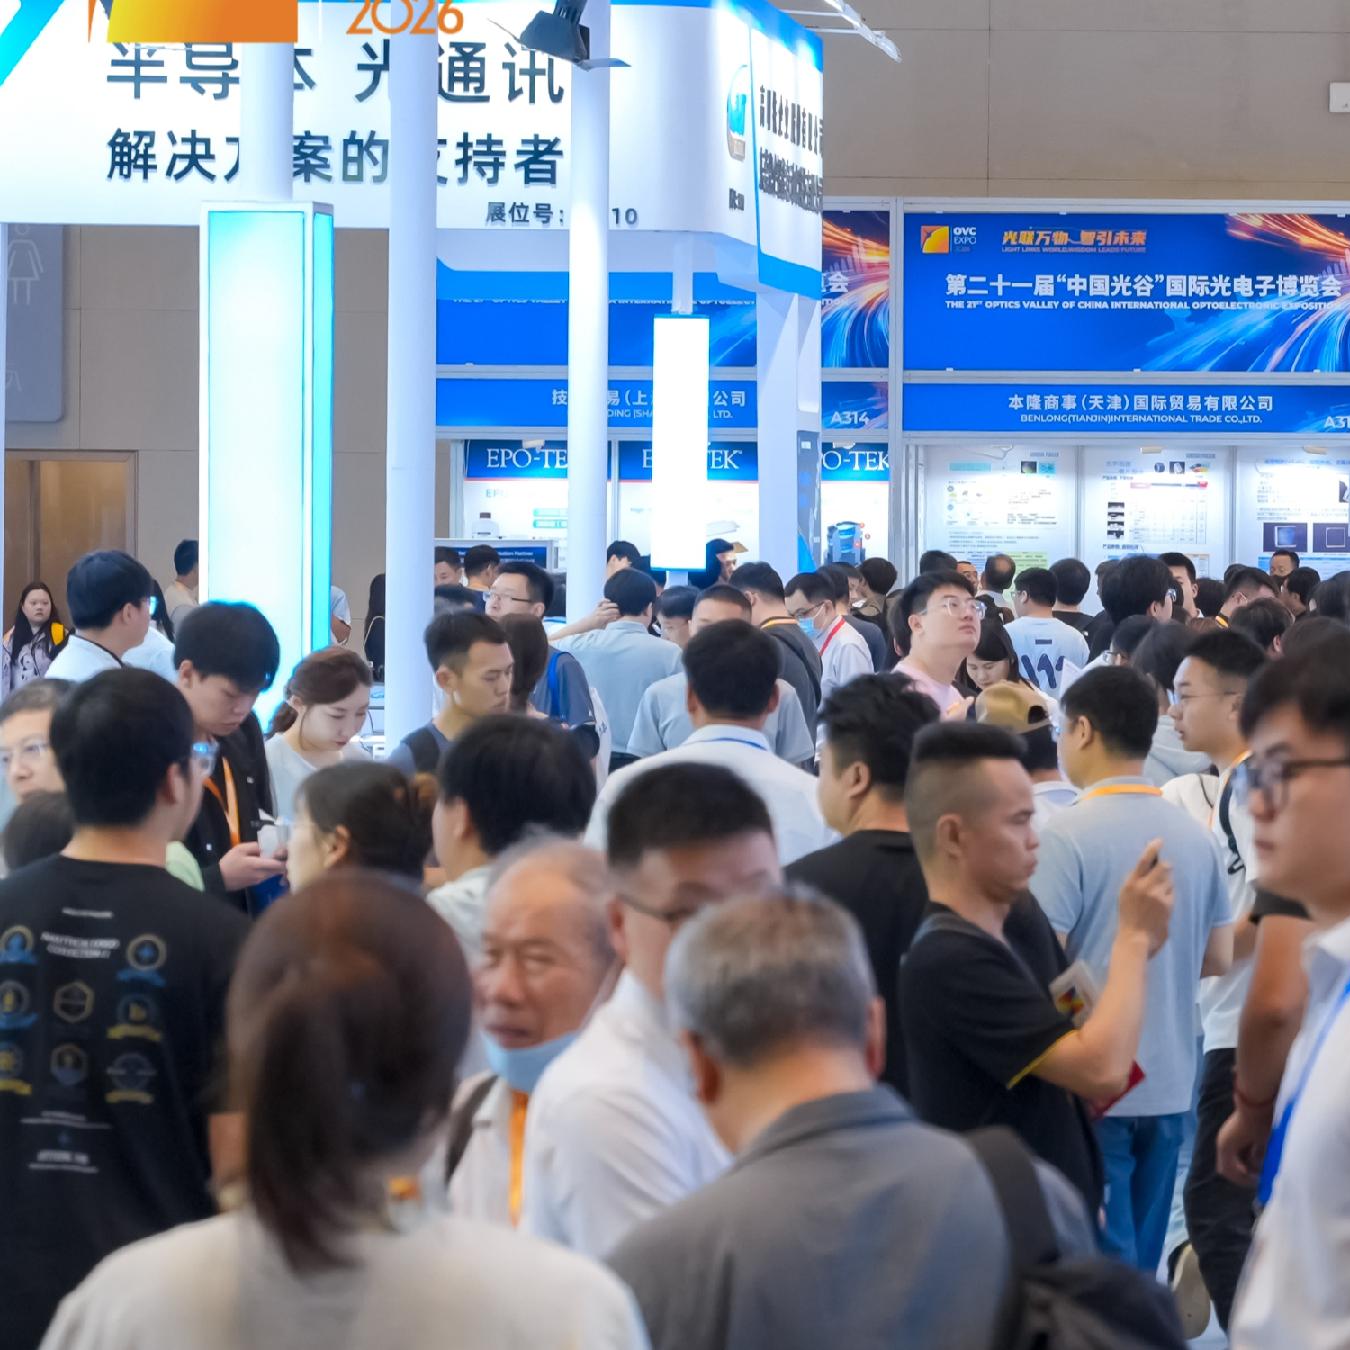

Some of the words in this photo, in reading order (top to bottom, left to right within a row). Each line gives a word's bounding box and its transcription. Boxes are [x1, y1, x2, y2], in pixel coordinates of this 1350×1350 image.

[106, 127, 564, 185] 解决案的持者
[953, 227, 977, 236] OVC
[945, 273, 1342, 297] 第二十一届“中国光谷”国际光电子博览会
[945, 301, 964, 309] THE
[984, 301, 1021, 309] OPTICS
[1022, 301, 1059, 309] VALLEY
[1062, 301, 1076, 309] OF
[1077, 301, 1109, 309] CHINA
[1110, 301, 1190, 309] INTERNATIONAL
[1008, 394, 1274, 411] 本隆商事（天津）国际贸易有限公司
[607, 409, 631, 418] DING
[830, 411, 870, 425] A314
[1190, 415, 1222, 423] TRADE
[486, 448, 568, 469] EPO-TE
